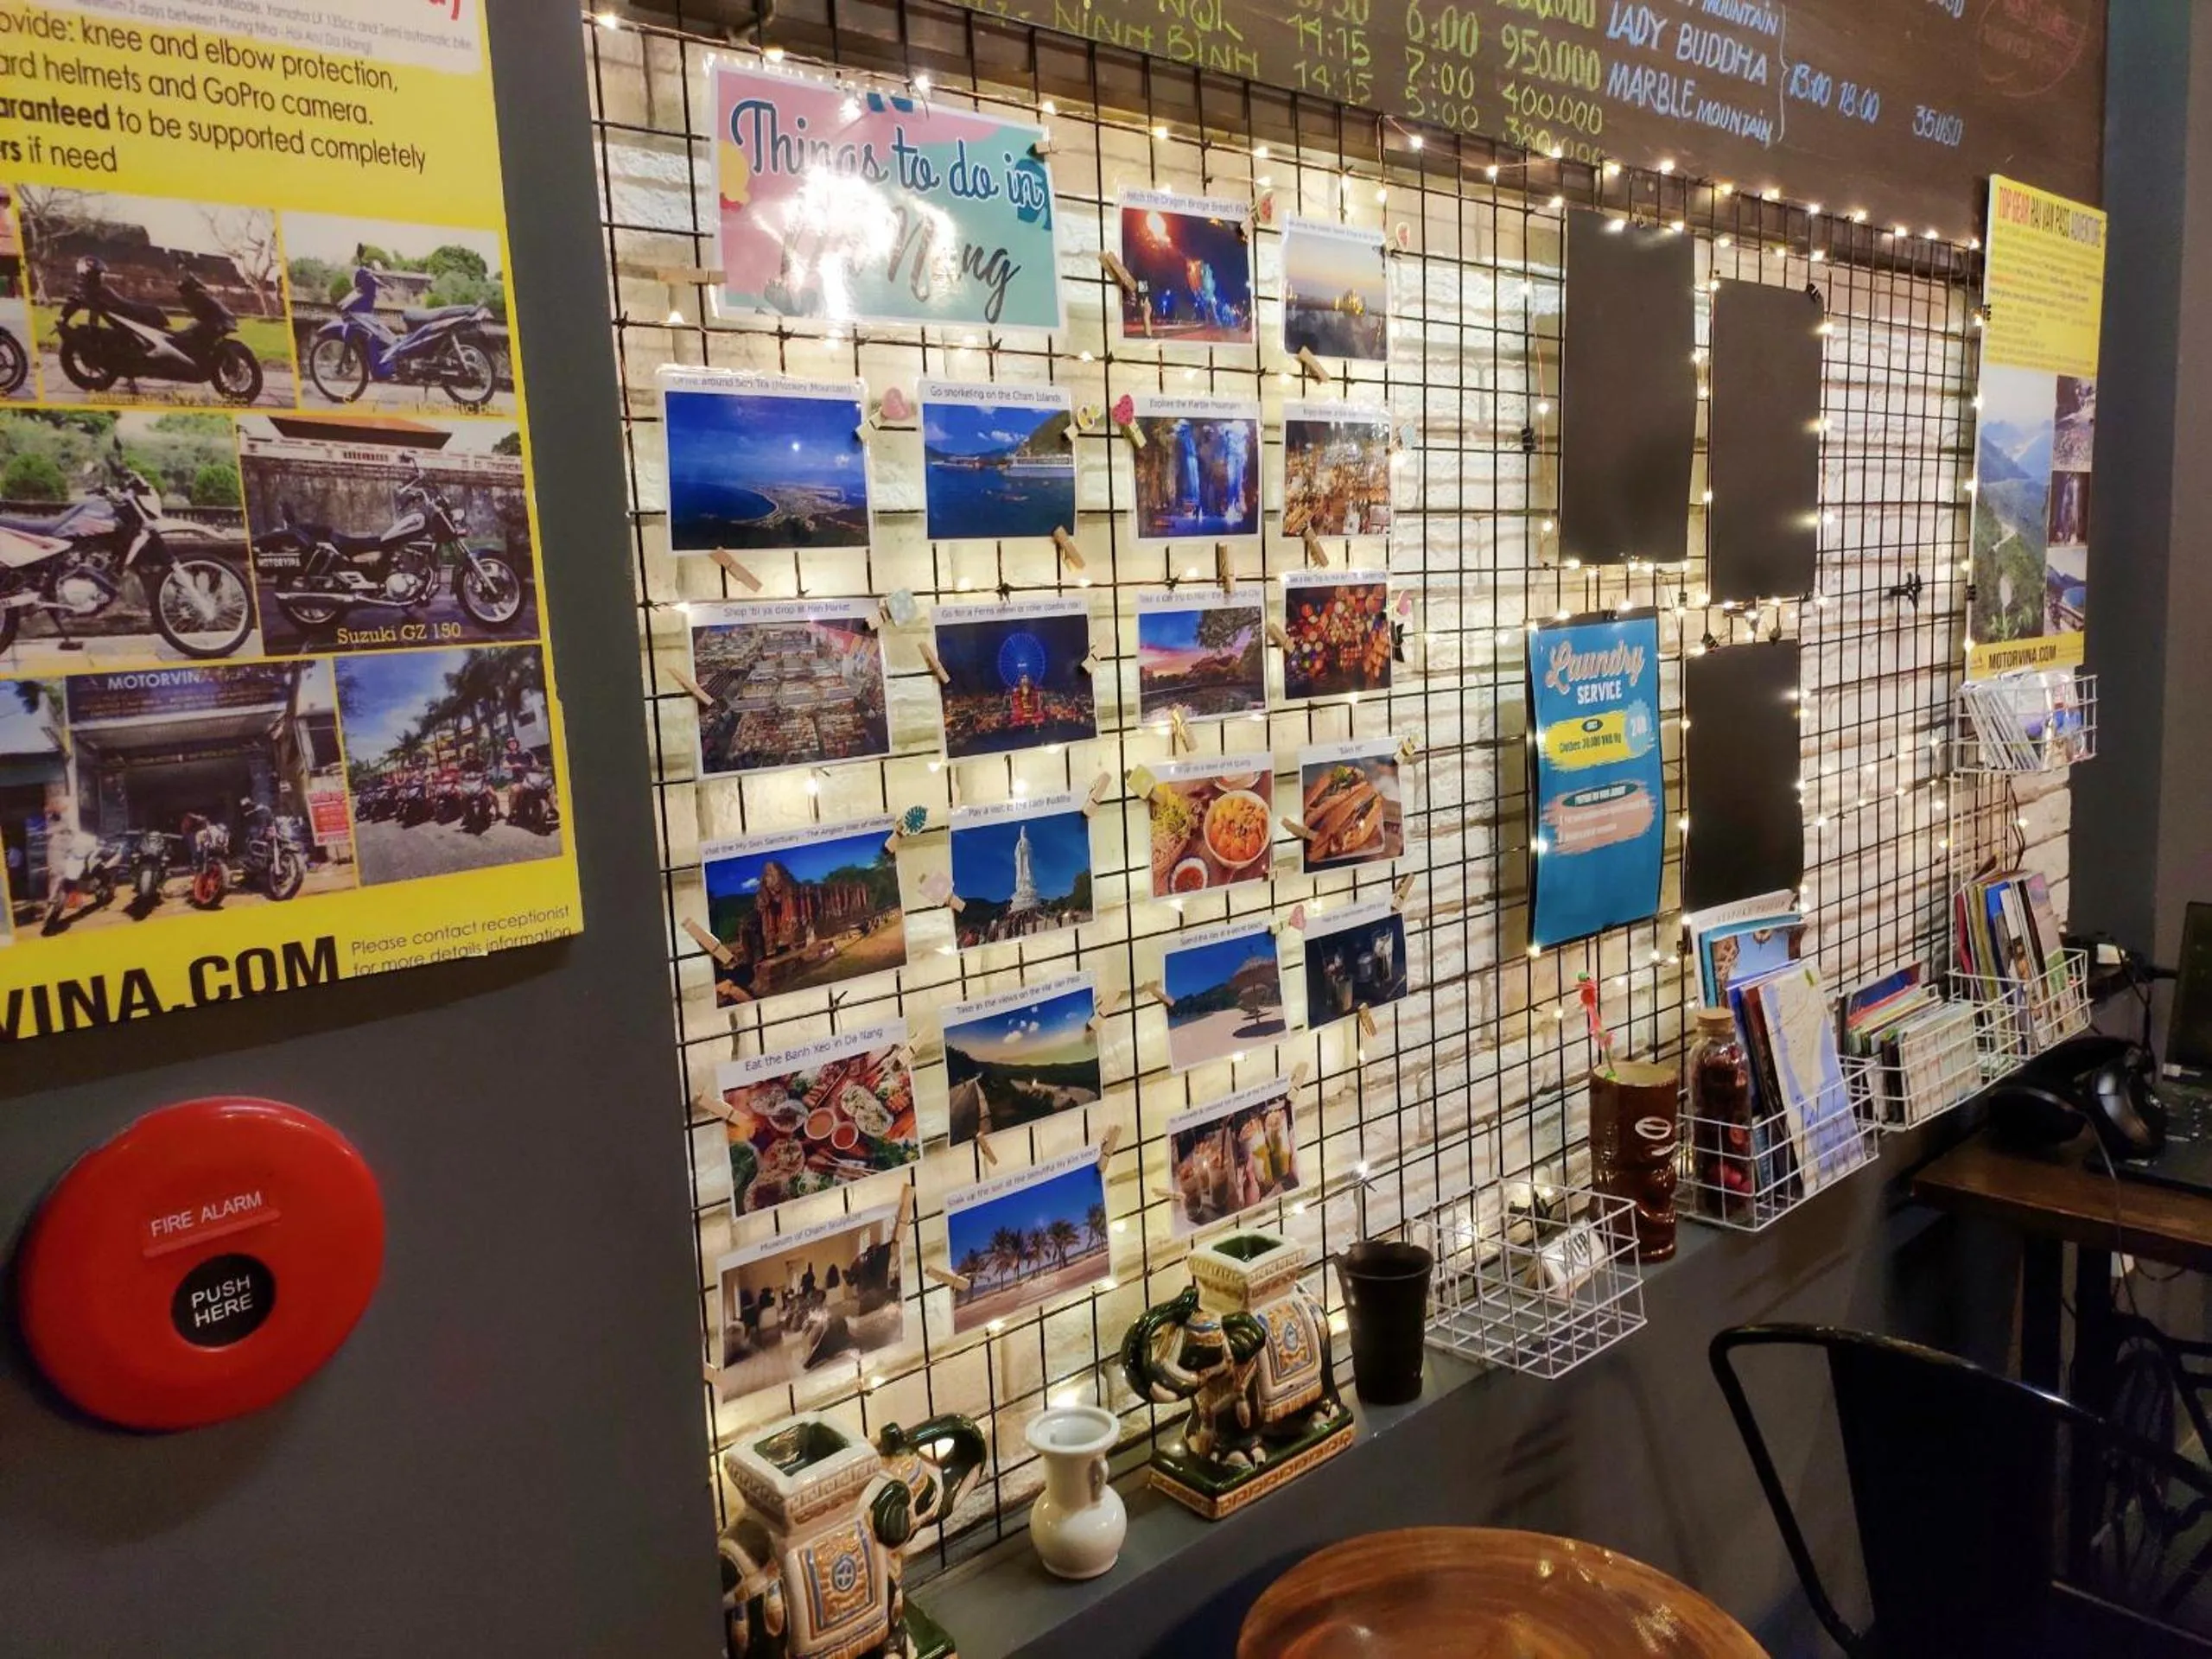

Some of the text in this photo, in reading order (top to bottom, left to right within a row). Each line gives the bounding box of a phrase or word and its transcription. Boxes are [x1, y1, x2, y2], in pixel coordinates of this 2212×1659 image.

[80, 16, 143, 52] knee
[150, 34, 199, 60] and
[205, 39, 276, 71] elbow
[282, 54, 399, 92] protection,
[1501, 22, 1601, 92] 950.000
[1605, 1, 1669, 51] LADY
[1675, 22, 1768, 86] BUDDHA
[43, 55, 142, 93] helmets
[149, 74, 198, 100] and
[204, 77, 276, 112] GoPro
[282, 93, 373, 125] camera.
[1405, 46, 1475, 100] 7:00
[1501, 79, 1603, 135] 400.000
[1405, 86, 1479, 130] 5:00
[1605, 61, 1696, 119] MARBLE
[27, 136, 41, 162] if
[50, 145, 118, 173] need
[118, 105, 142, 135] to
[149, 110, 181, 139] be
[188, 120, 304, 154] supported
[311, 135, 426, 174] completely
[892, 124, 940, 191] to
[950, 138, 1000, 200] do
[1005, 152, 1046, 208] in
[701, 378, 734, 388] around
[930, 385, 943, 397] Go
[944, 387, 984, 400] snorkeling
[986, 391, 996, 399] on
[997, 390, 1011, 400] the
[336, 626, 397, 645] Suzuki
[400, 624, 427, 640] GZ
[723, 606, 747, 618] Shop
[107, 668, 213, 691] MOTORVIN
[1545, 639, 1646, 696] Laundry
[1988, 644, 2057, 671] MOTORVINA.COM
[1577, 679, 1623, 706] SERVICE
[351, 905, 569, 957] Please contact receptionist
[353, 925, 573, 976] for more details information
[745, 1059, 762, 1071] Eat
[765, 1055, 783, 1067] the
[785, 1046, 811, 1062] Banh
[813, 1043, 831, 1055] Xeo
[834, 1039, 842, 1049] in
[150, 1191, 262, 1237] FIRE ALARM
[191, 1274, 251, 1309] PUSH
[194, 1293, 254, 1328] HERE
